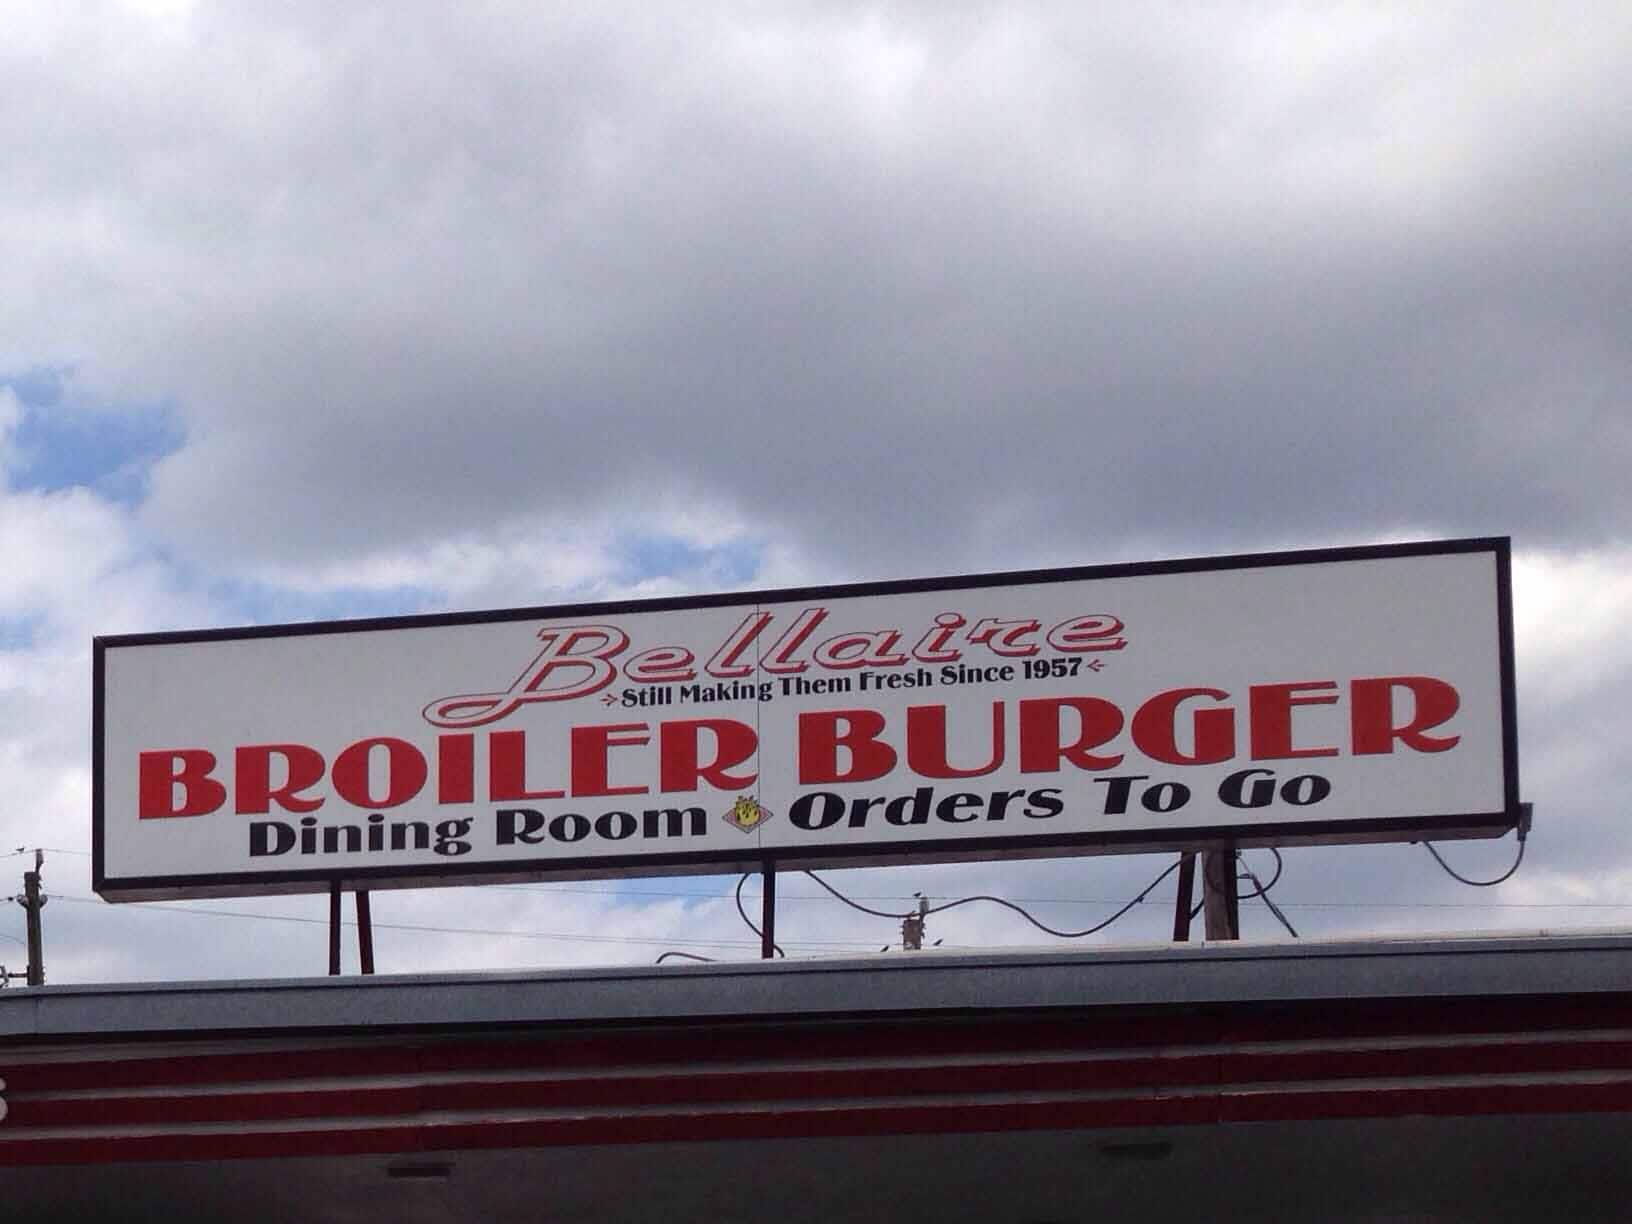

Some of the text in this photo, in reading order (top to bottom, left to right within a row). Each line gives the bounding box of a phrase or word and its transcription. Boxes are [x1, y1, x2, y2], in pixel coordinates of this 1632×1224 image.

[422, 607, 1128, 729] Bellaire
[620, 657, 1083, 708] Still Making Them Fresh Since 1957
[138, 675, 1461, 820] BROILER BURGER
[788, 768, 1332, 831] Orders To Go
[249, 807, 708, 858] Dining Room
